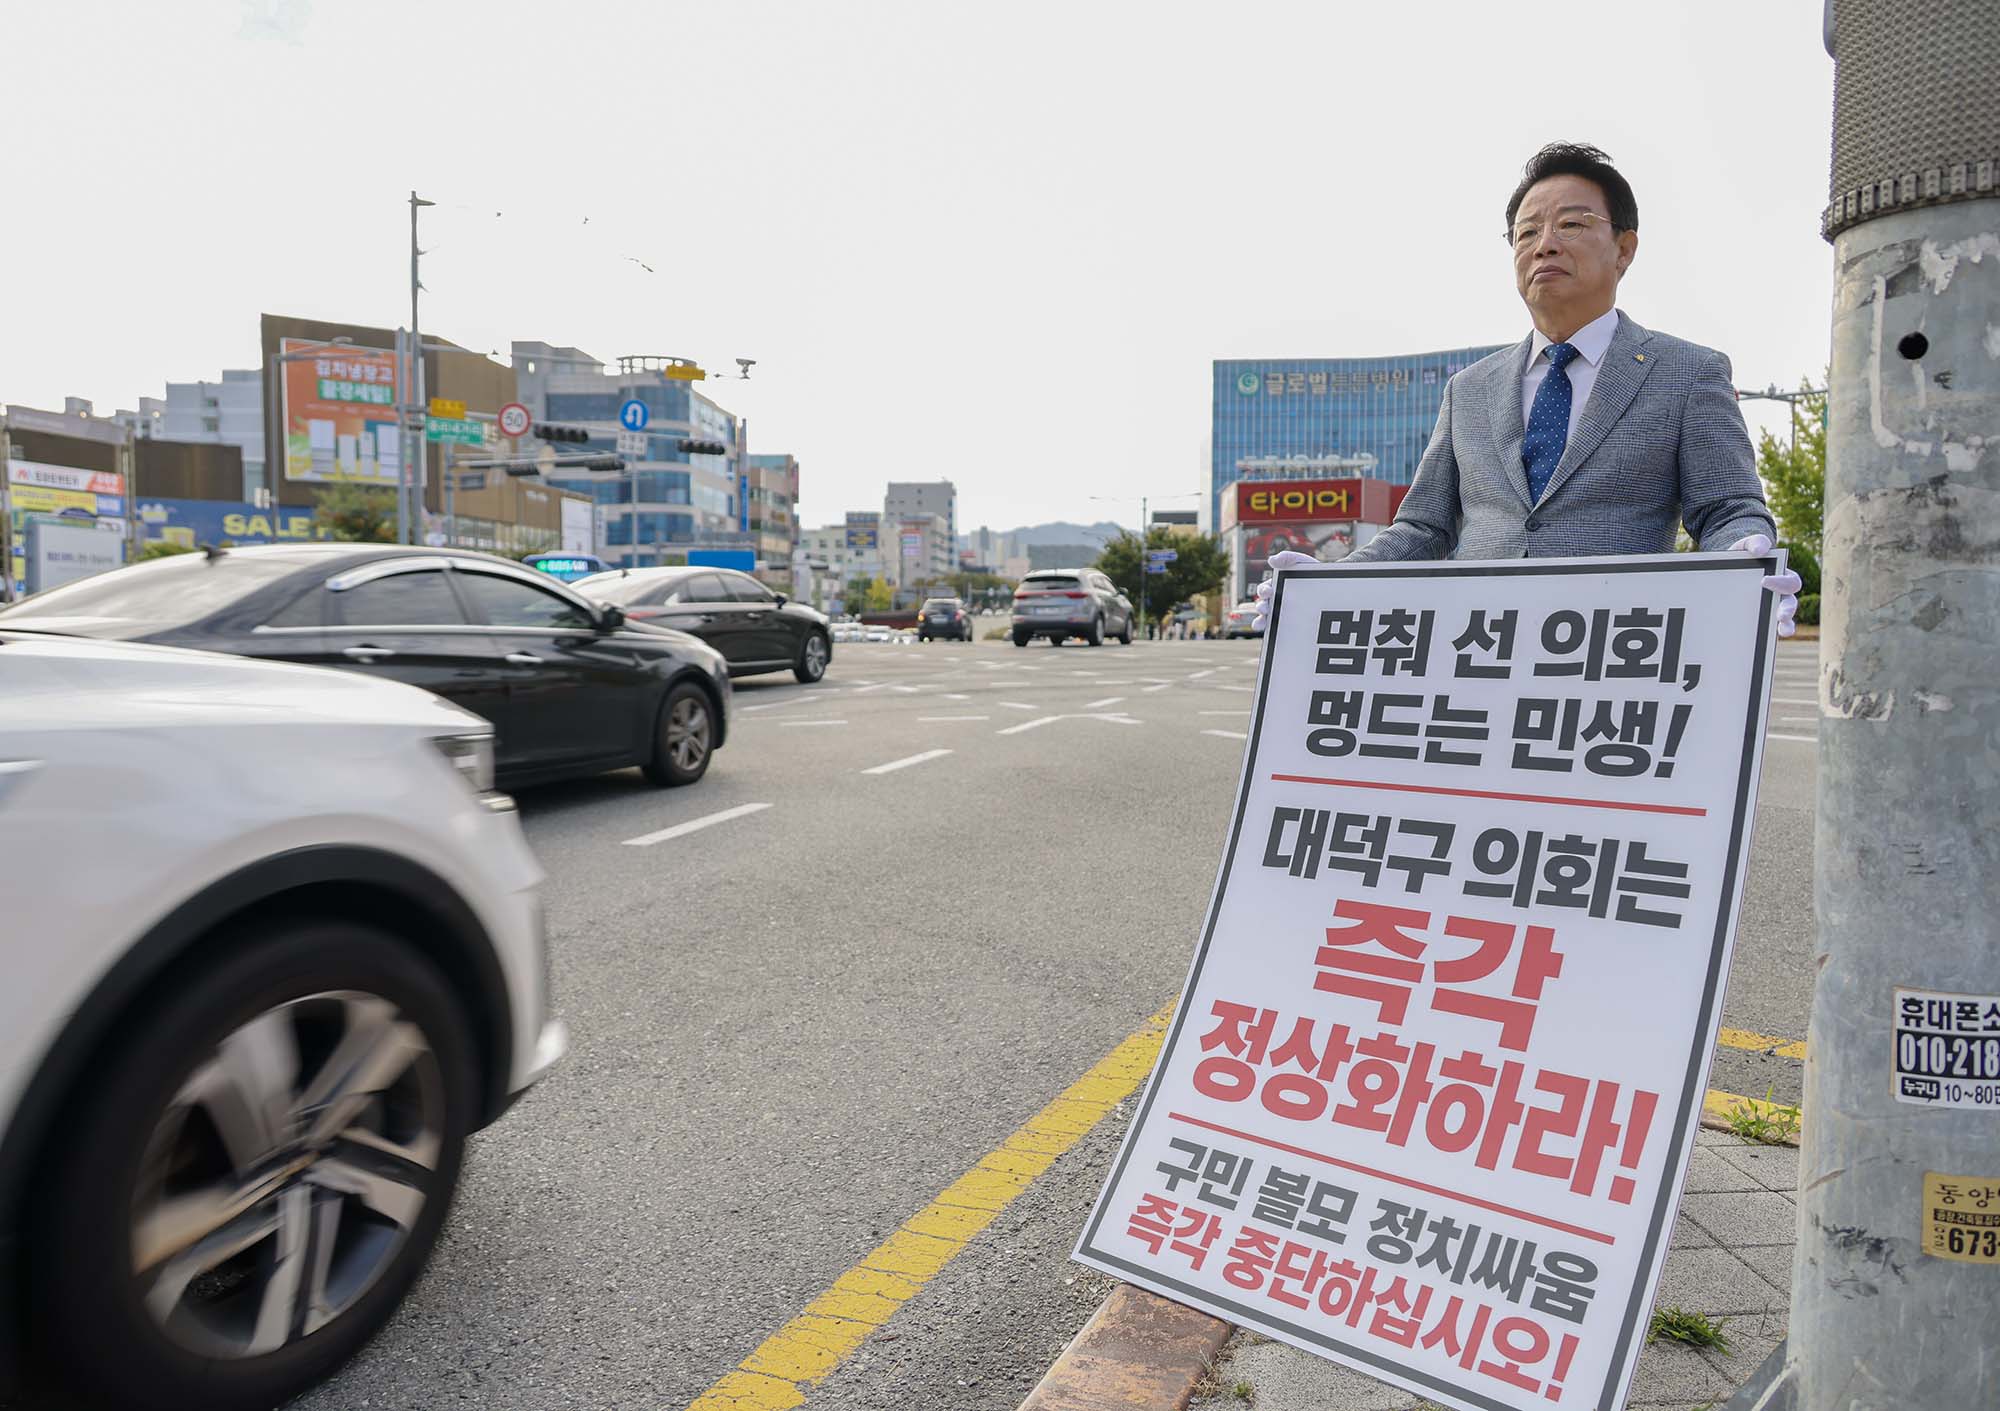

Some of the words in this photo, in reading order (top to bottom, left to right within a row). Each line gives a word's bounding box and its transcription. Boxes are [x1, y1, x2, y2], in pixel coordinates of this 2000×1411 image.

[504, 411, 524, 428] 50
[223, 513, 312, 538] SALE
[1251, 488, 1348, 515] 타이어
[1314, 608, 1436, 678] 멈춰
[1451, 609, 1519, 680] 선
[1533, 607, 1702, 693] 의회,
[1305, 690, 1490, 767] 멍드는
[1511, 697, 1694, 779] 민생!
[1262, 806, 1457, 894] 대덕구
[1462, 827, 1691, 930] 의회는
[1313, 898, 1565, 1053] 즉각
[1192, 998, 1660, 1206] 정상화하라!
[1155, 1137, 1254, 1212] 구민
[1252, 1165, 1359, 1246] 볼모
[1366, 1198, 1600, 1325] 정치싸움
[1935, 1184, 2000, 1208] 동양
[1126, 1193, 1223, 1271] 즉각
[1221, 1225, 1580, 1403] 중단하십시오!
